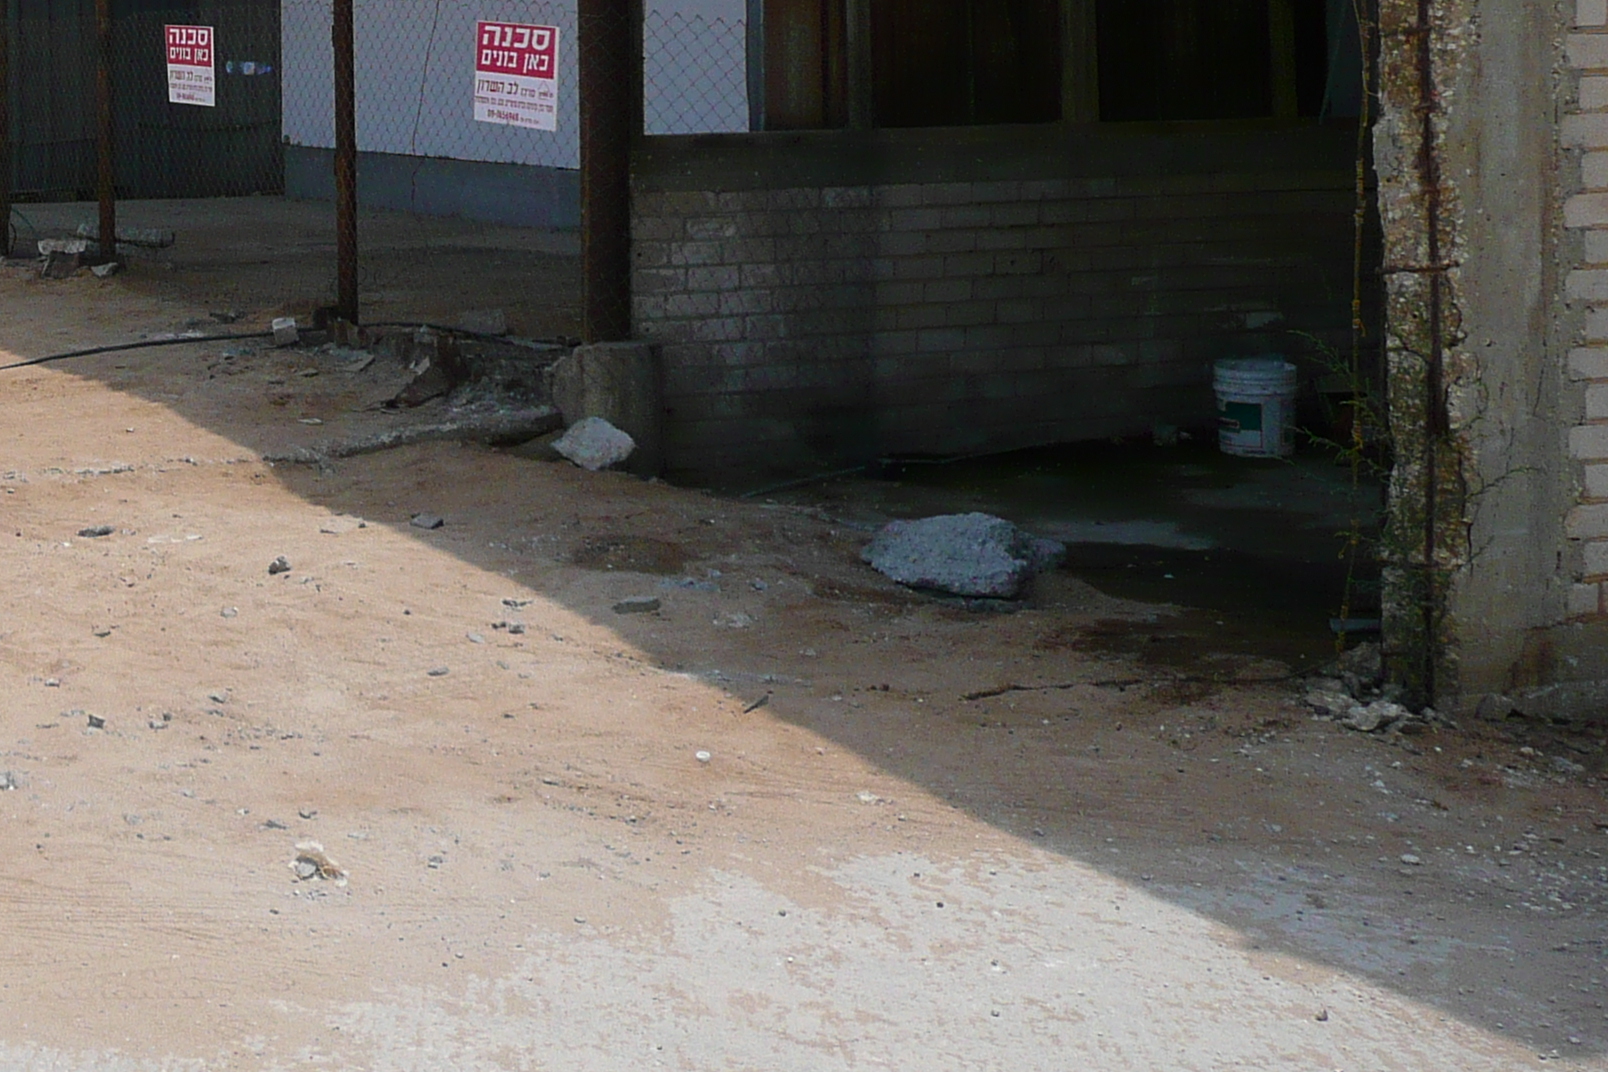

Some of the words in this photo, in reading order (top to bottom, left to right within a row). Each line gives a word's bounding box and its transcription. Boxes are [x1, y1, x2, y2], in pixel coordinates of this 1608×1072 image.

[169, 28, 209, 46] סכנה
[482, 25, 550, 50] סכנה
[170, 47, 191, 60] בונים
[194, 49, 209, 64] כאן
[481, 49, 517, 68] בונים
[523, 53, 549, 73] כאן
[507, 81, 519, 96] לב
